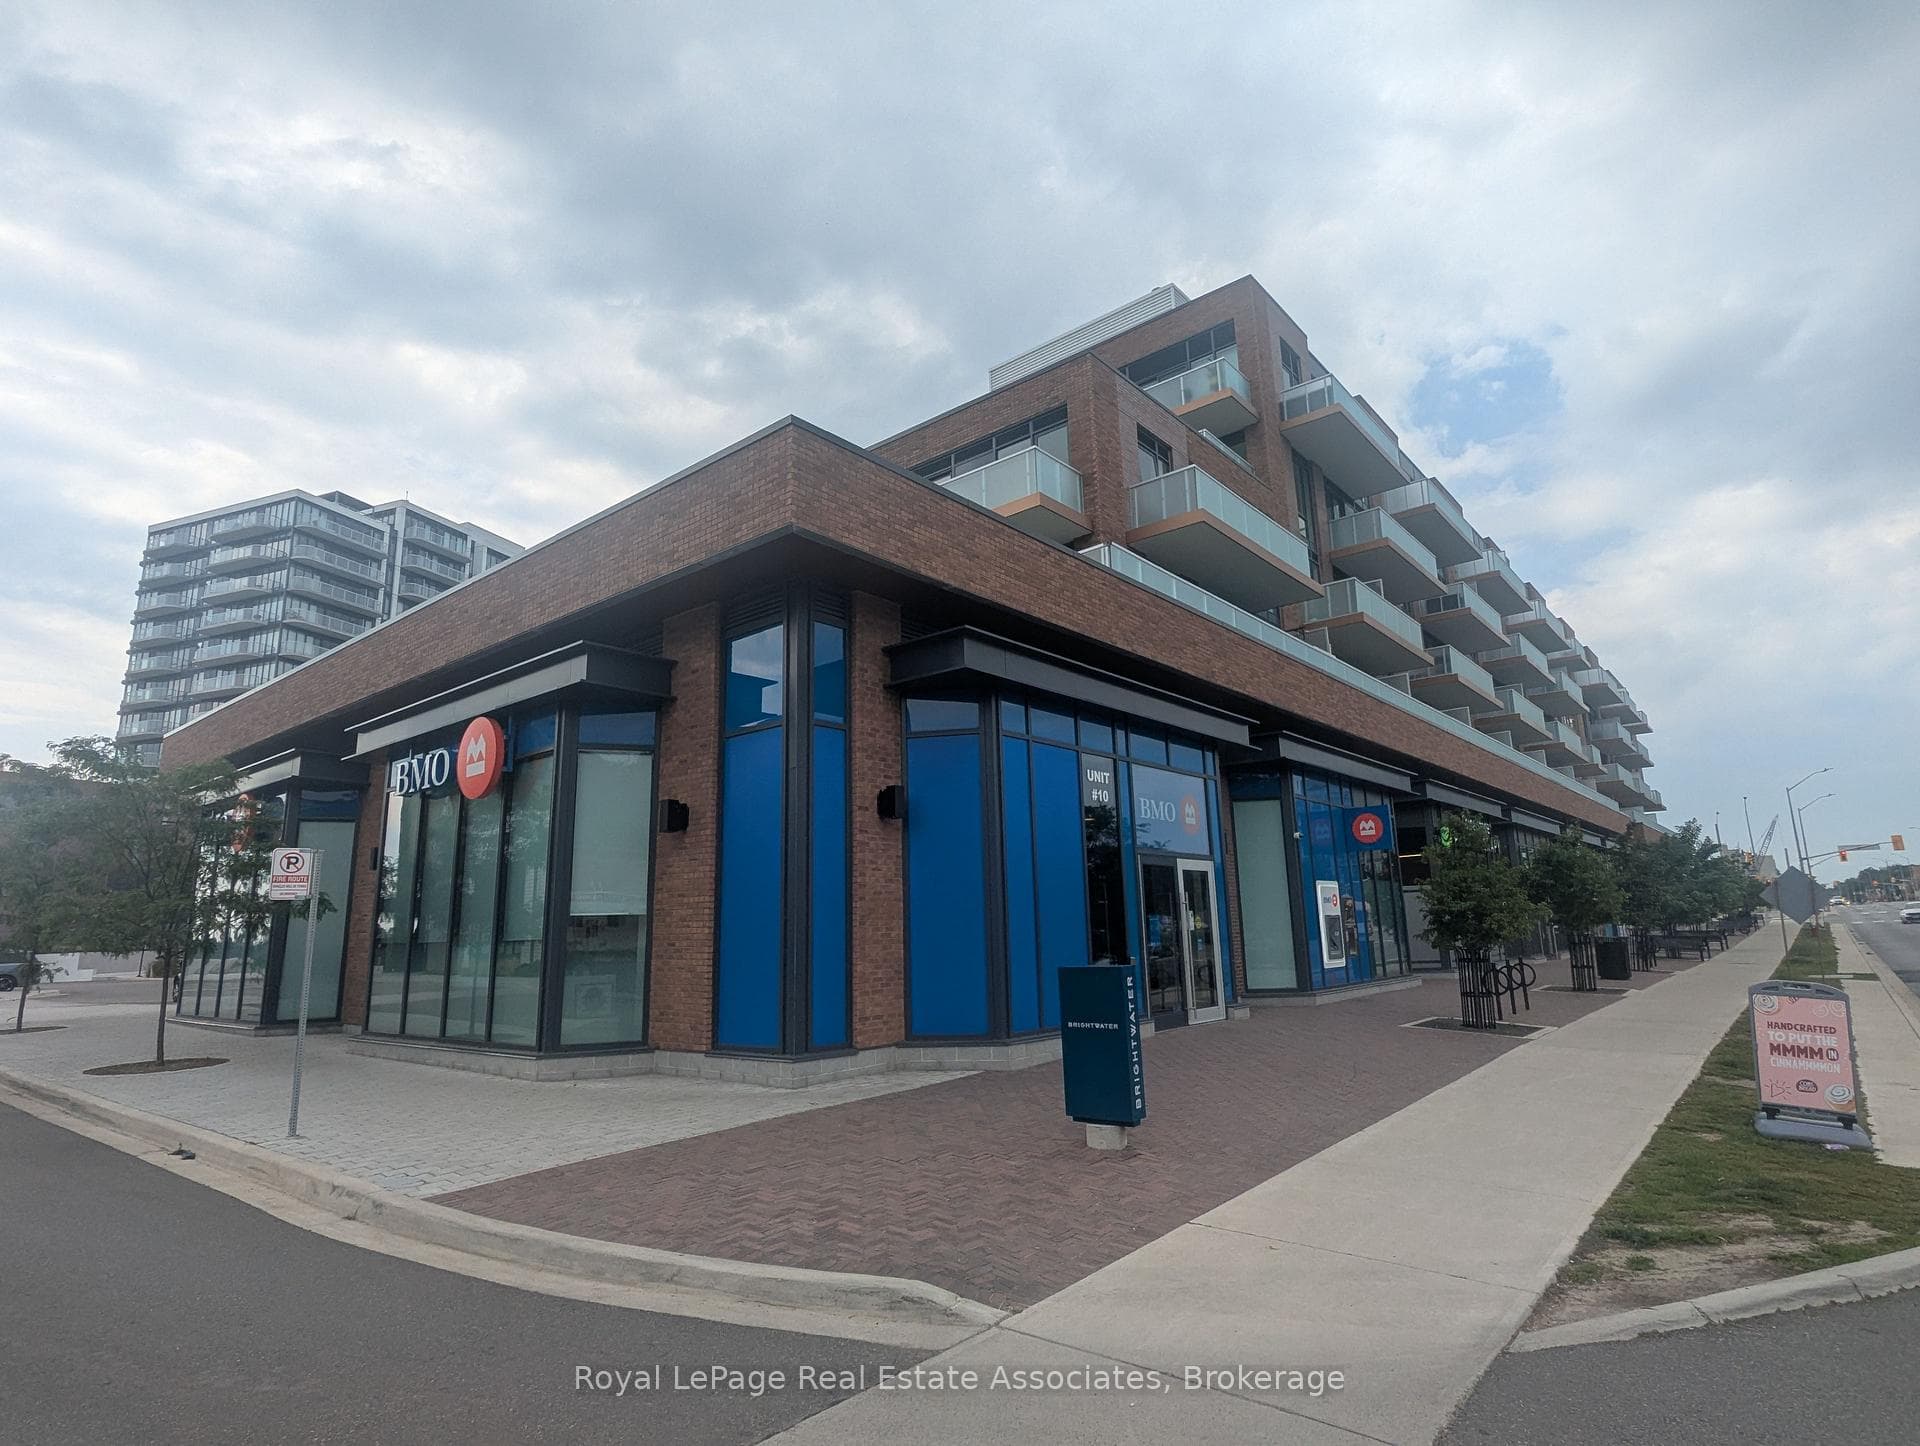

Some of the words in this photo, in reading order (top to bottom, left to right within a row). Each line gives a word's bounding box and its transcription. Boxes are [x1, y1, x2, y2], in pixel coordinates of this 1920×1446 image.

[395, 749, 450, 796] BMO
[1087, 769, 1110, 784] UNIT
[1091, 788, 1109, 802] #10
[1139, 798, 1176, 822] BMO
[1068, 1021, 1119, 1029] BRIGHTWATER
[1767, 1021, 1837, 1034] HANDCRAFTED
[1127, 976, 1142, 1110] BRIGHTWATER
[1768, 1031, 1786, 1041] TO
[1788, 1033, 1812, 1045] PUT
[1815, 1035, 1839, 1047] THE
[1769, 1043, 1824, 1060] MMMM
[1827, 1049, 1838, 1060] IN
